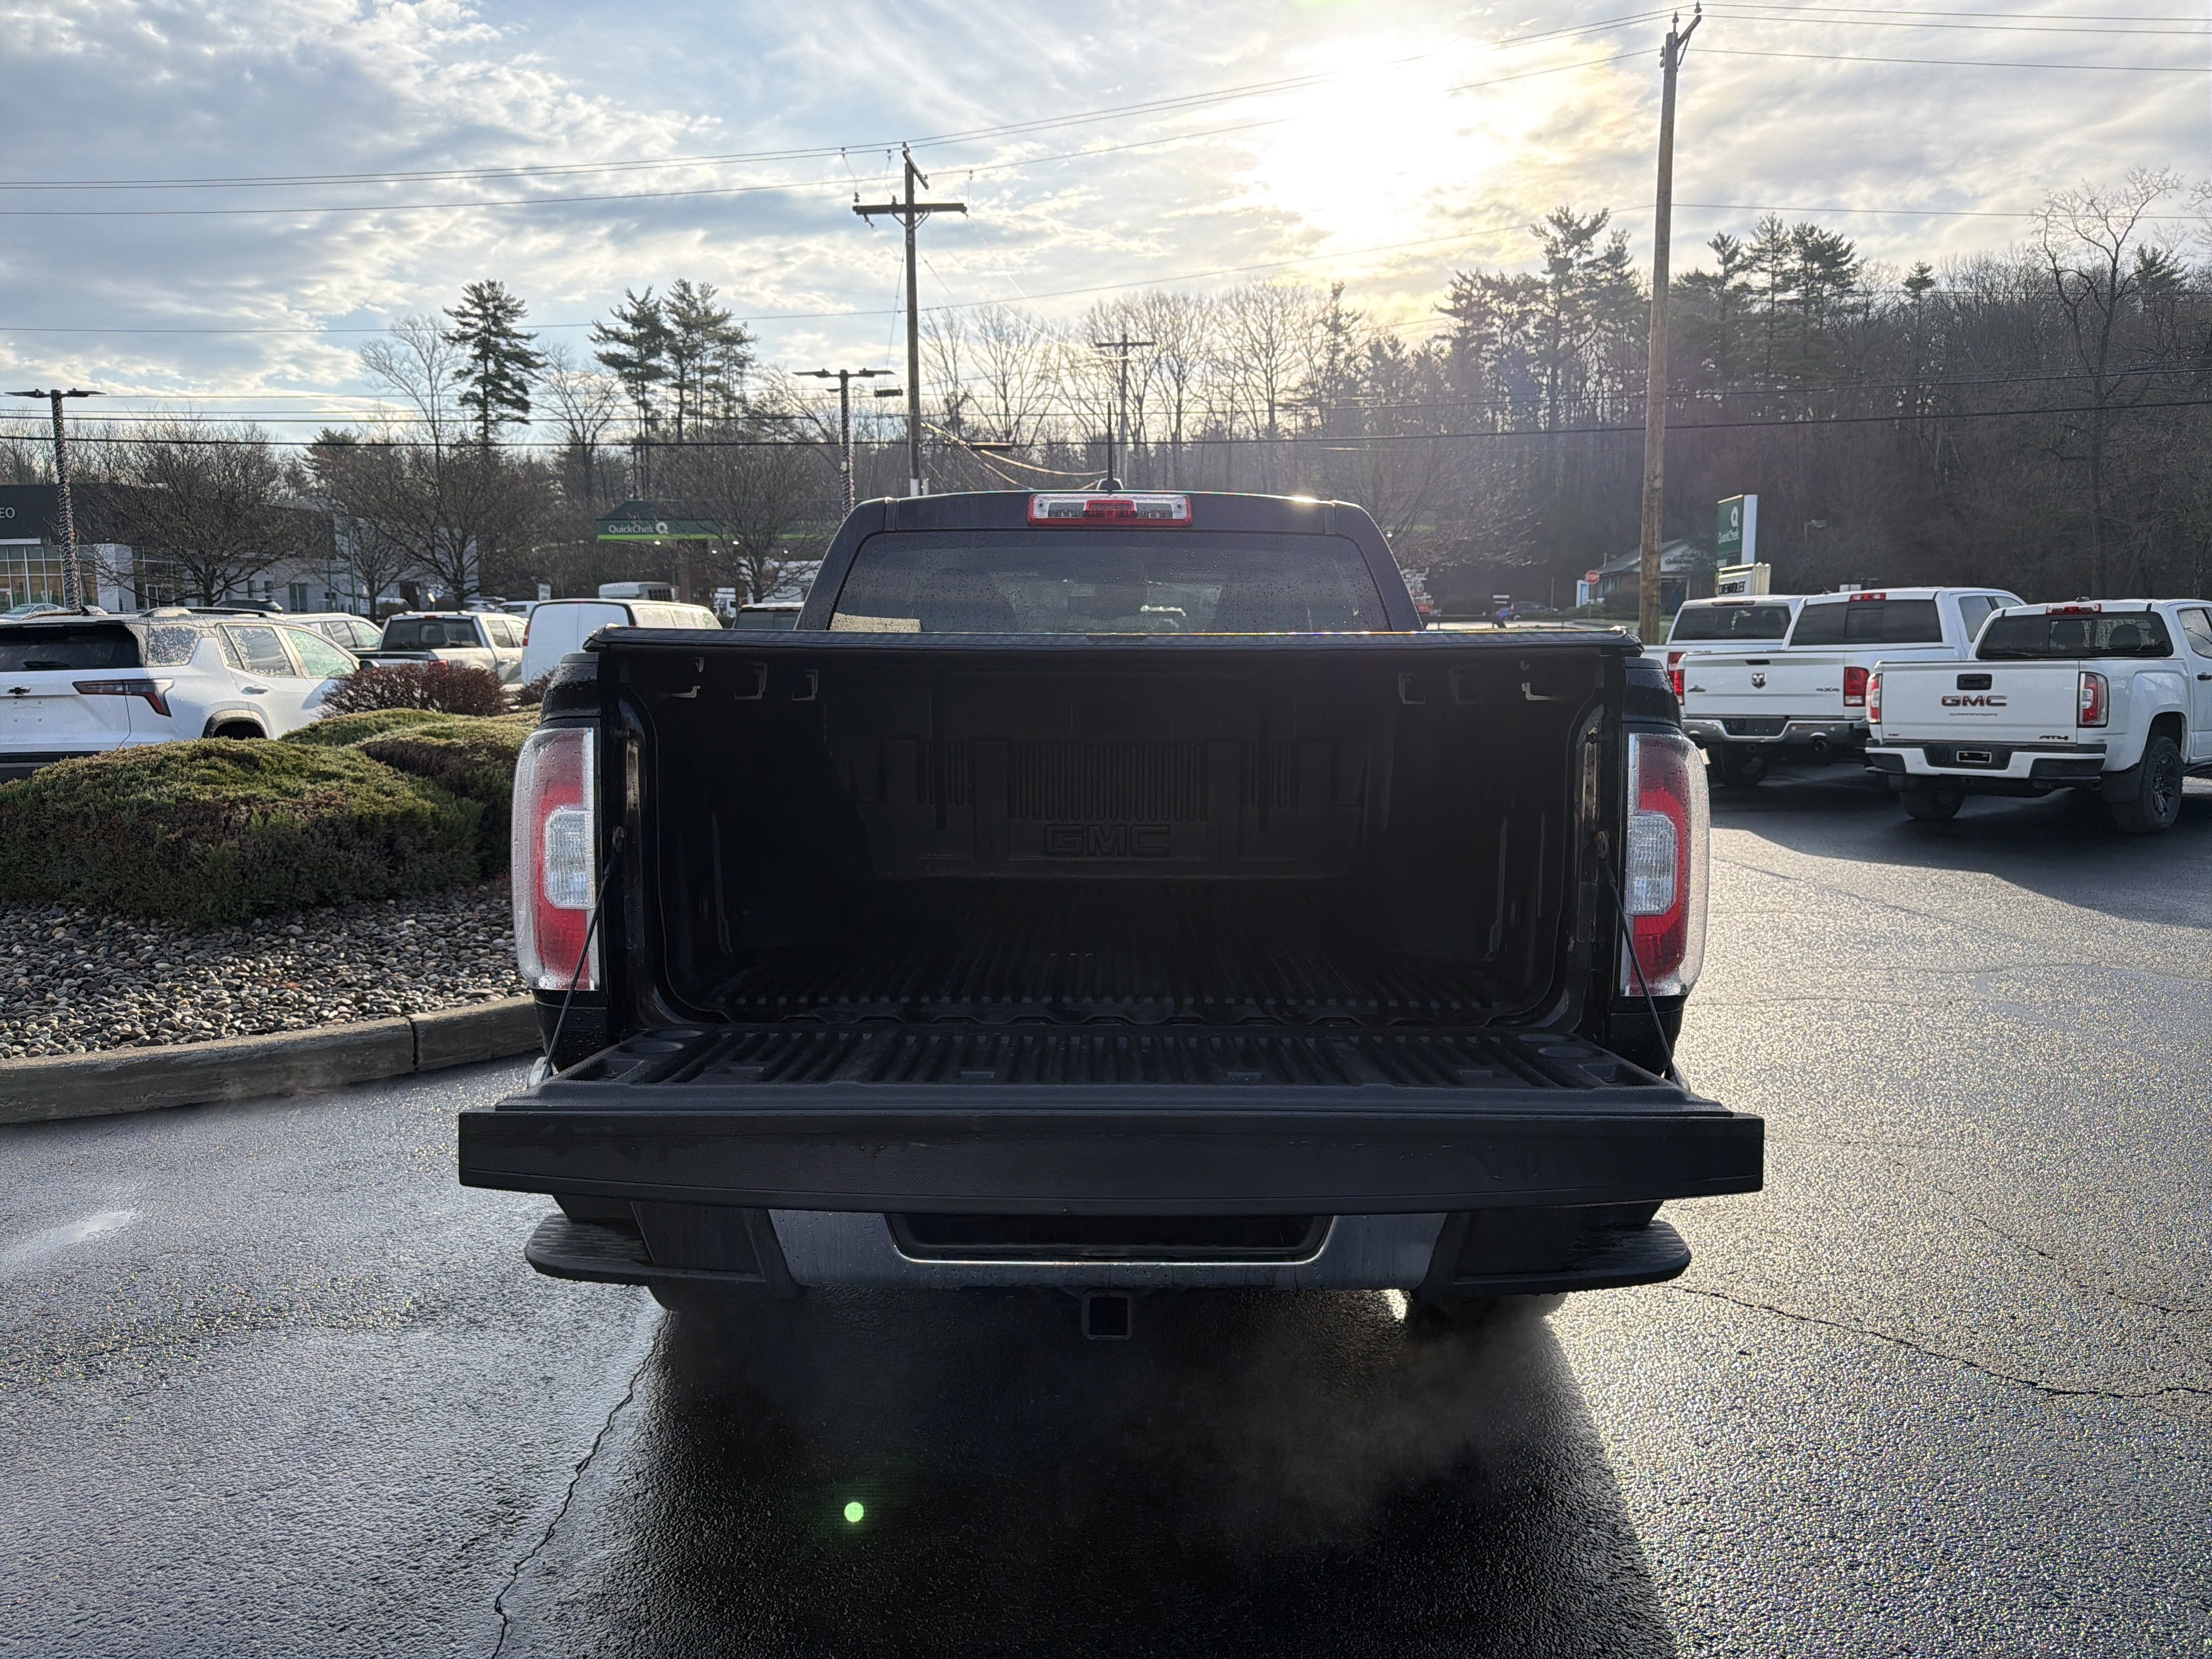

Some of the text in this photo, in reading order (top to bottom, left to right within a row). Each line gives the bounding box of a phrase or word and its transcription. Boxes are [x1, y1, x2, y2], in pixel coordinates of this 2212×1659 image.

[608, 524, 654, 534] QuickChek
[1942, 695, 2007, 707] GMC
[1044, 824, 1170, 857] GMC
